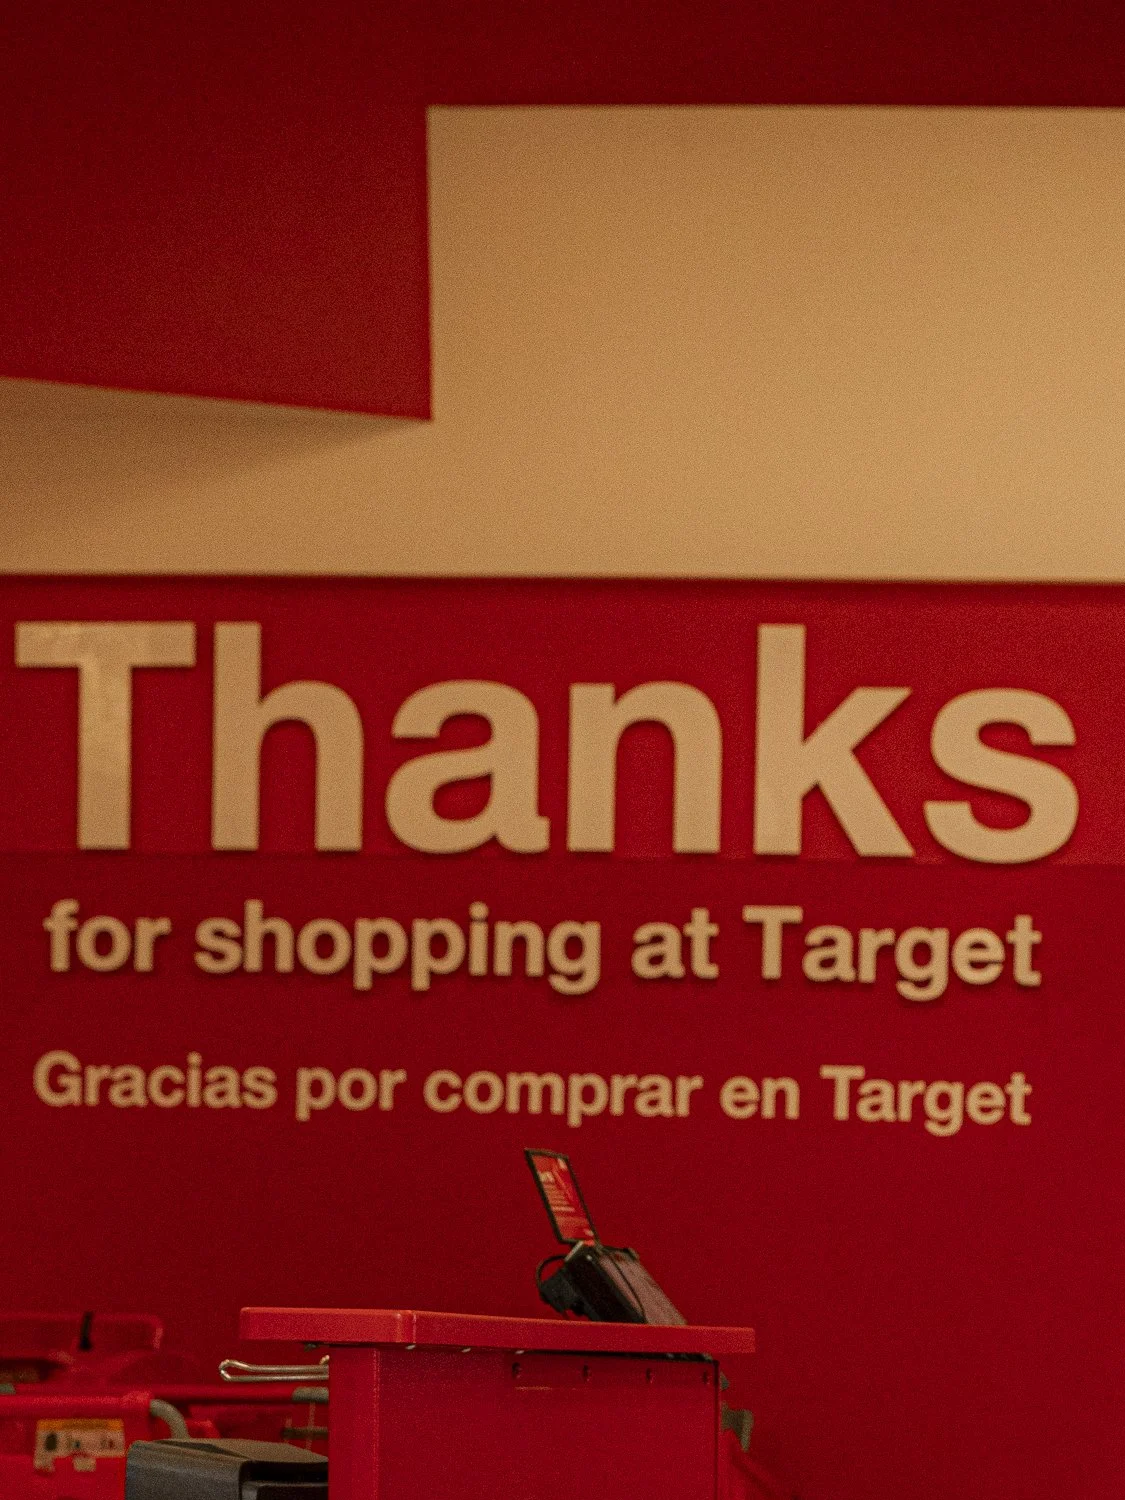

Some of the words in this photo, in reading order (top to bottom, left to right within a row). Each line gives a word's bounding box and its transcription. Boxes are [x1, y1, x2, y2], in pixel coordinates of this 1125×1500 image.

[16, 622, 1079, 863] Thanks
[44, 900, 170, 972] for
[195, 900, 601, 995] shopping
[632, 908, 719, 979] at
[743, 906, 1042, 1001] Target
[34, 1051, 277, 1108] Gracias
[296, 1068, 406, 1121] por
[424, 1071, 703, 1128] comprar
[720, 1077, 800, 1119] en
[820, 1065, 1032, 1136] Target
